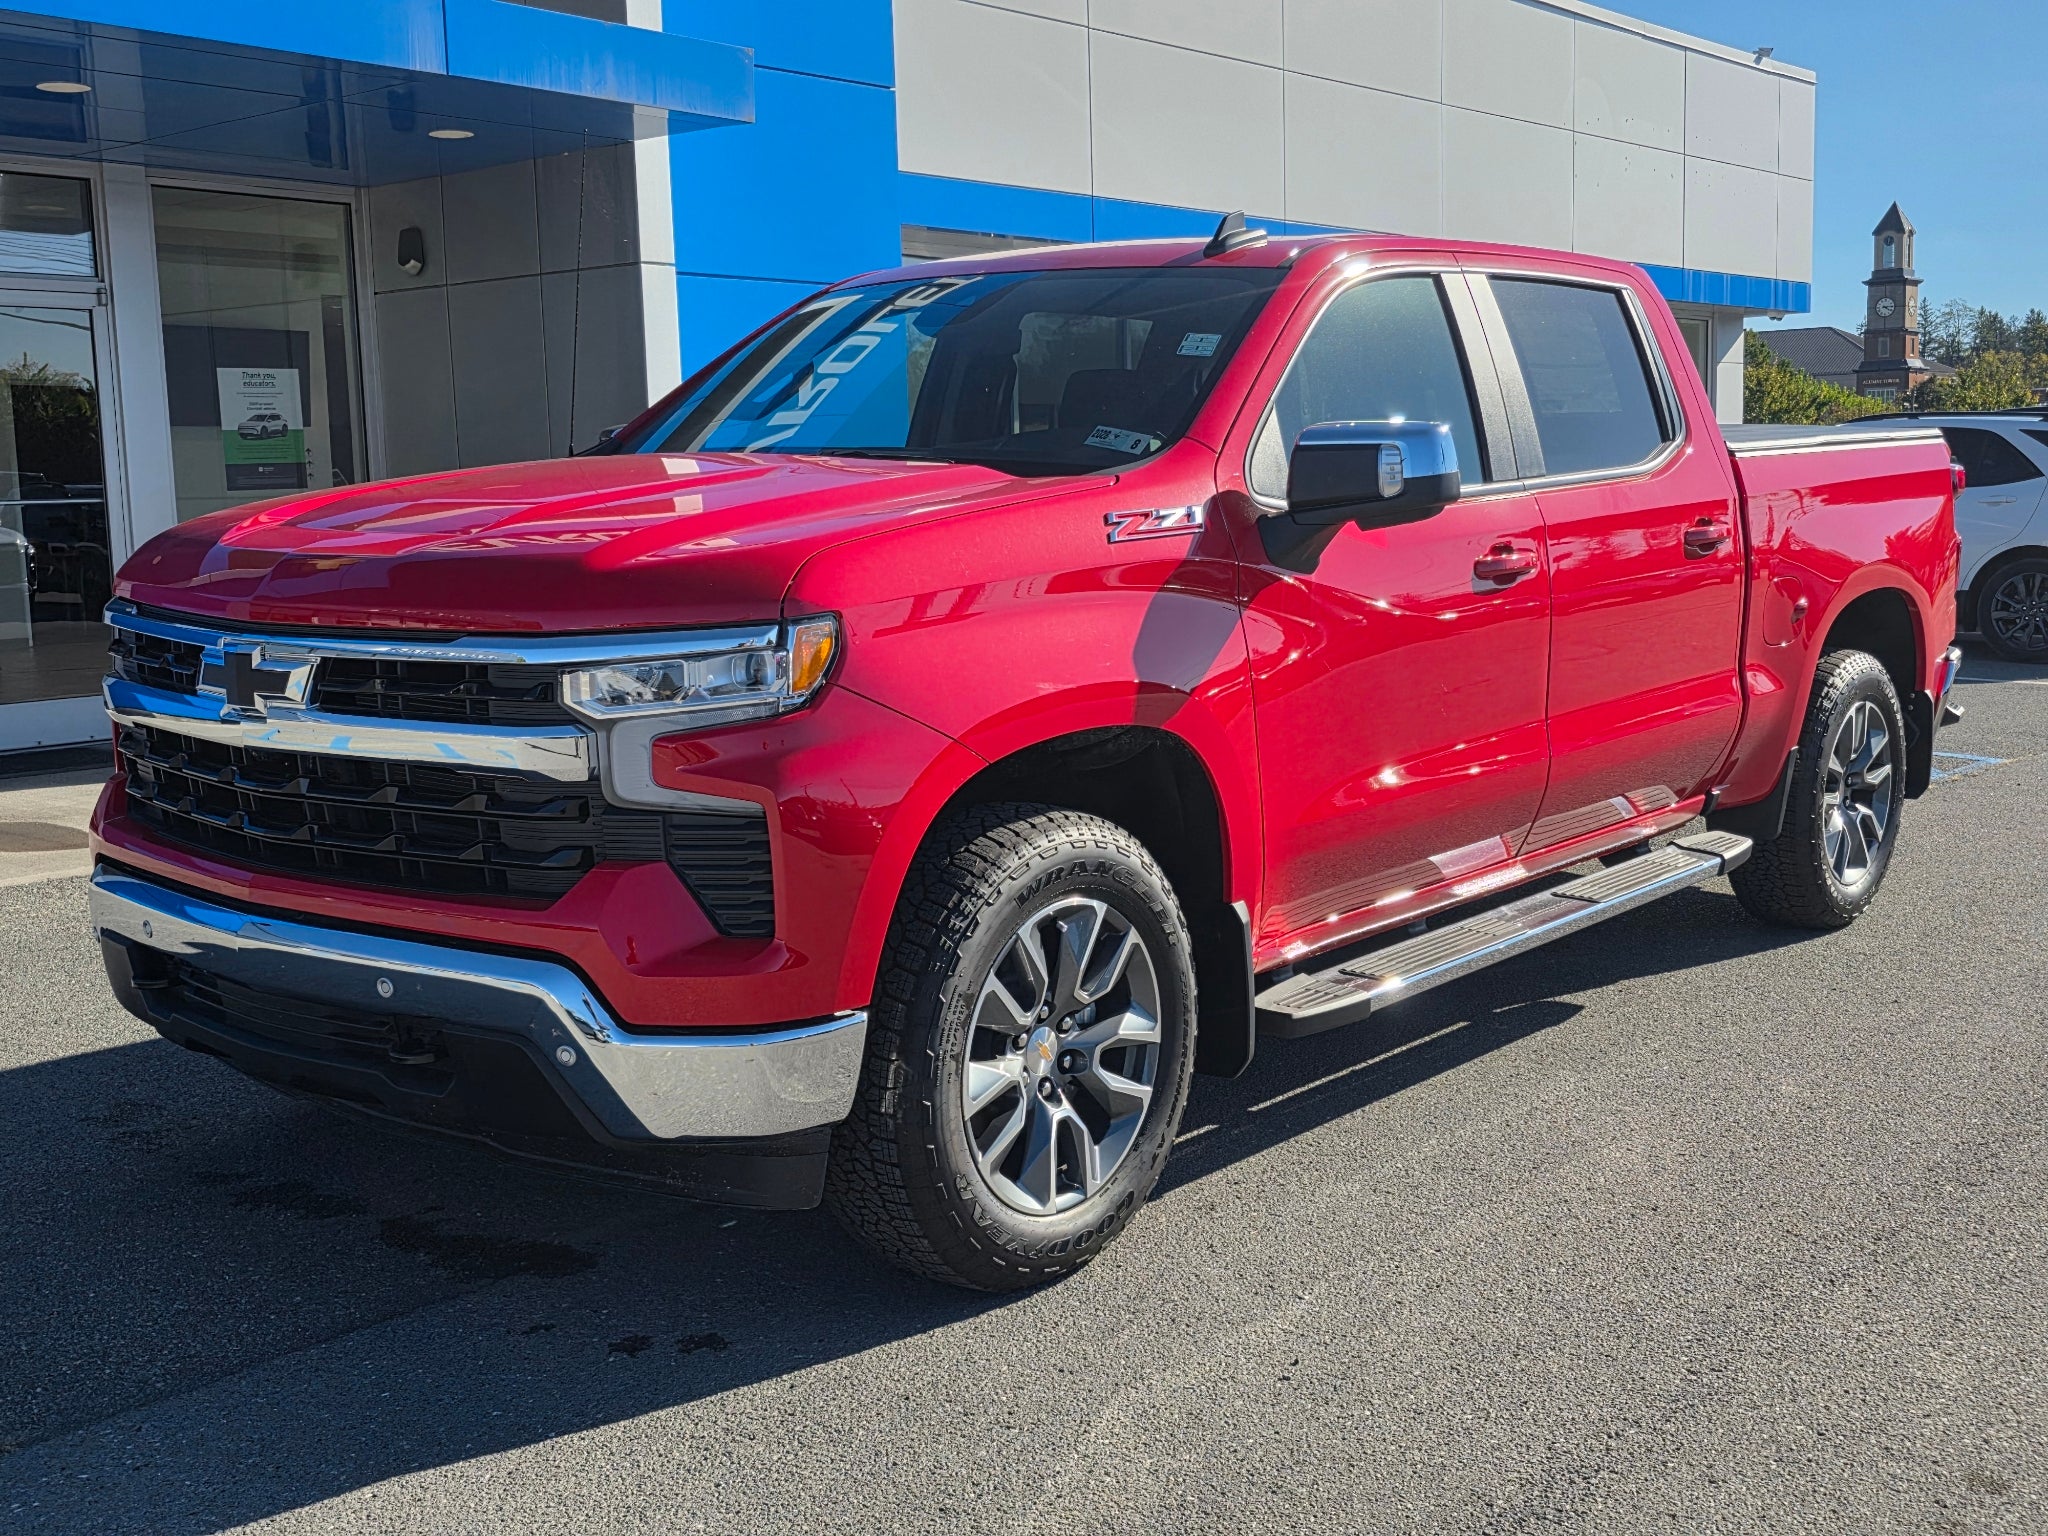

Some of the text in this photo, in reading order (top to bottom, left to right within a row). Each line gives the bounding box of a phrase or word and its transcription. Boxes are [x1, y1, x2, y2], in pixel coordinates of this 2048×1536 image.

[241, 371, 261, 379] Thank
[1131, 439, 1142, 450] 8
[1103, 505, 1204, 544] Z71
[1014, 859, 1180, 948] WRANGLER
[955, 1173, 1135, 1260] GOODYEAR
